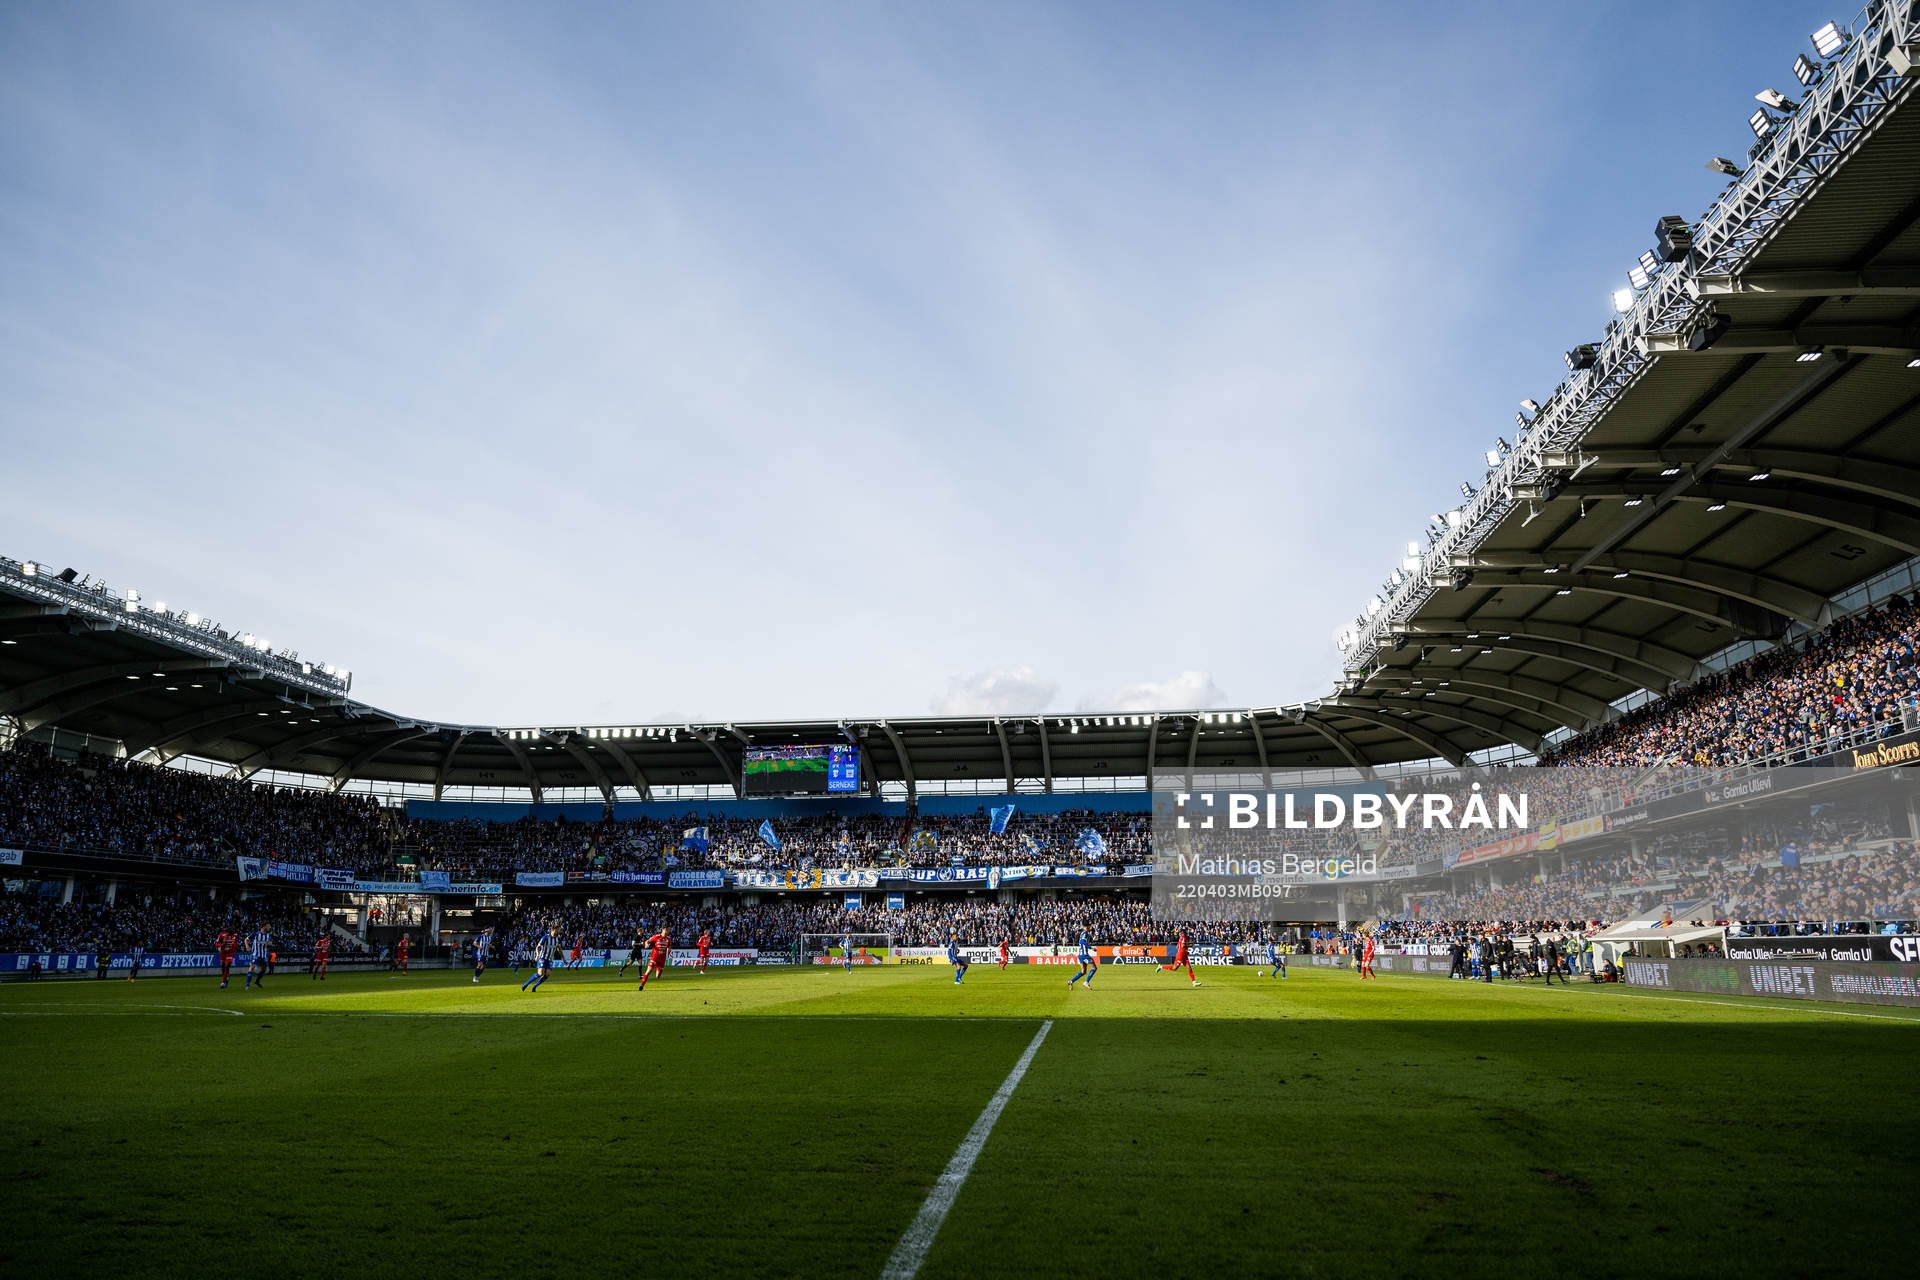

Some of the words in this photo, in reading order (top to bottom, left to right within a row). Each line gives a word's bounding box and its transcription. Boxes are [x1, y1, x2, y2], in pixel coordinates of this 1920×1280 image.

[829, 780, 855, 788] SERNEKE
[1723, 783, 1748, 799] Gamla
[1748, 776, 1771, 793] Ullevi
[966, 949, 997, 958] morris
[1125, 956, 1159, 964] ELEDA
[1187, 955, 1233, 965] ERNEKE
[1730, 948, 1753, 960] Gamla
[1753, 948, 1773, 960] Ullevi
[1831, 948, 1860, 961] Gamla
[161, 954, 215, 968] EFFEKTIV
[1625, 962, 1669, 987] UNIBET
[1749, 965, 1815, 995] UNIBET
